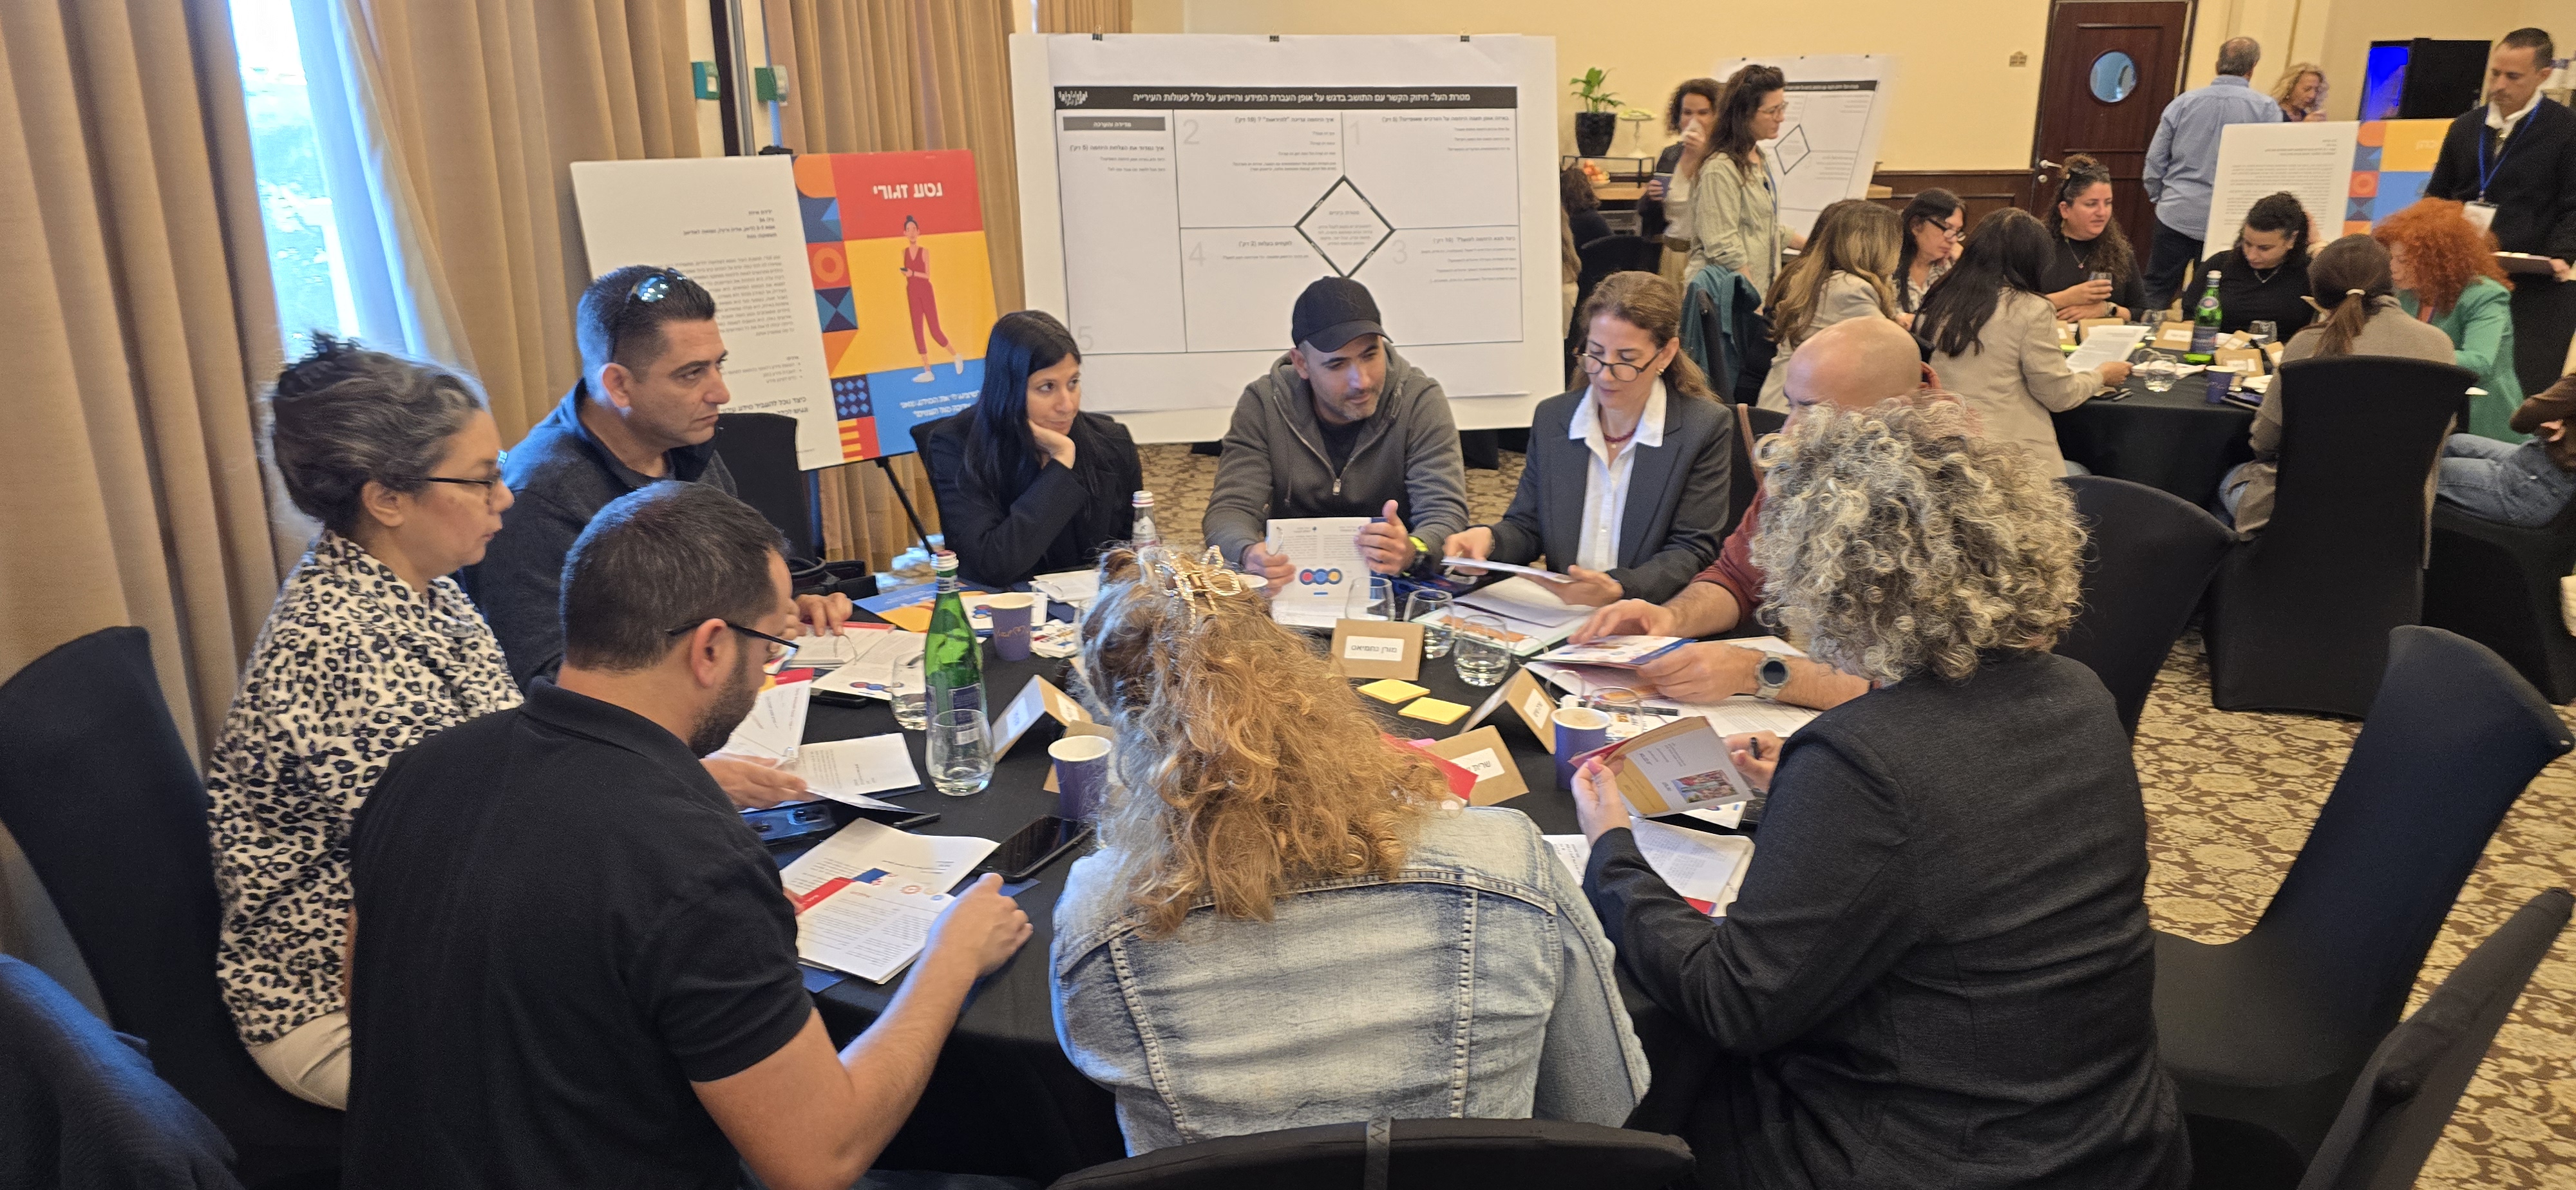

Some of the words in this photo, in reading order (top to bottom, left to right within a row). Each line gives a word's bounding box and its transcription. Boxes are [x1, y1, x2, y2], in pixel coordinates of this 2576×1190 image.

[1133, 93, 1162, 102] העירייה
[1163, 93, 1189, 102] פעולות
[1190, 93, 1205, 102] כלל
[1205, 93, 1217, 102] על
[1298, 94, 1313, 103] אופן
[1314, 93, 1325, 102] על
[1386, 94, 1408, 103] הקשר
[1409, 94, 1429, 103] חיזוק
[1183, 119, 1200, 145] 2
[1349, 120, 1360, 146] 1
[873, 184, 909, 200] זגורי
[913, 182, 943, 198] נטע
[1188, 241, 1207, 267] 4
[1392, 239, 1408, 265] 3
[1077, 325, 1094, 352] 5
[1472, 760, 1492, 771] שרית
